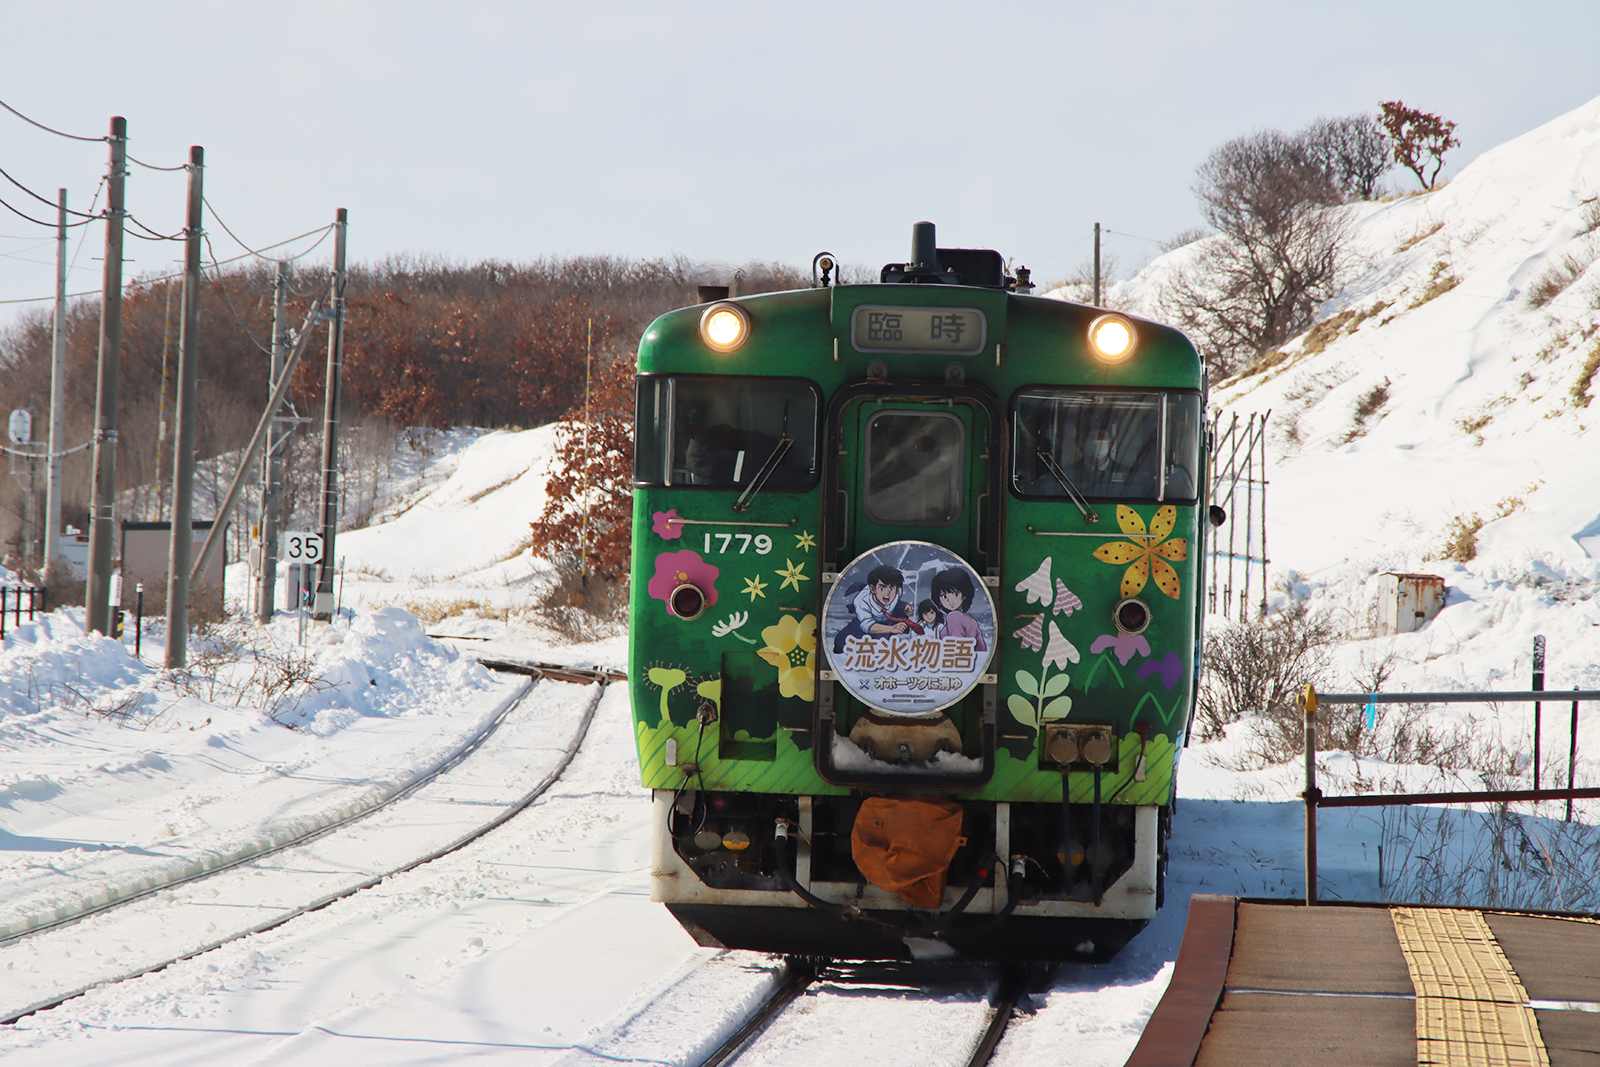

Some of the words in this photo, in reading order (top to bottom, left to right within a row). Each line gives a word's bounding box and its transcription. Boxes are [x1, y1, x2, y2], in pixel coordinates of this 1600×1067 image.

[289, 536, 319, 559] 35
[704, 533, 773, 555] 1779
[844, 637, 975, 670] 流氷物語
[874, 676, 963, 691] オホーツクに消ゆ
